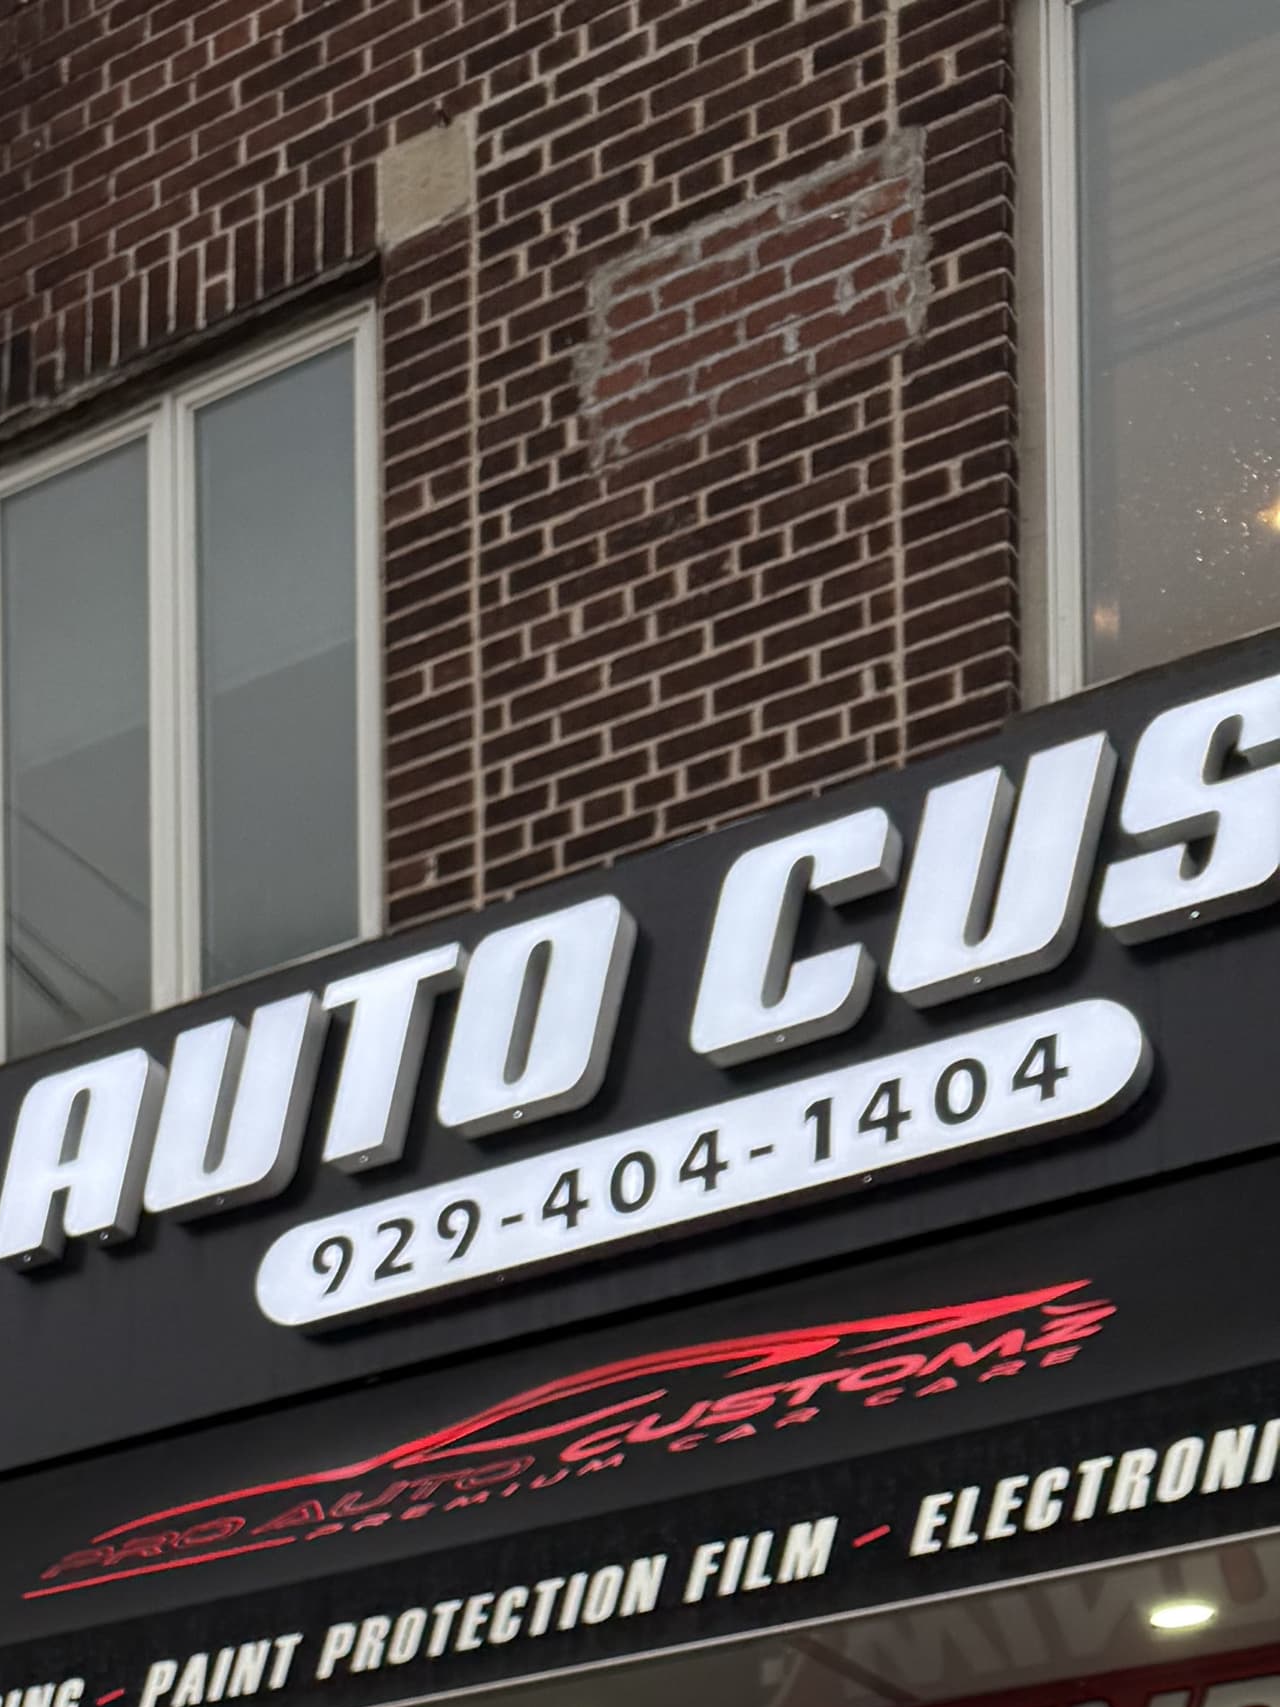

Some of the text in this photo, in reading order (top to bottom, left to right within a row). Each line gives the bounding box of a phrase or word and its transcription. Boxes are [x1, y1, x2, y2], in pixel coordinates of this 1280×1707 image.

[688, 679, 1280, 1063] CUS
[310, 1036, 1070, 1293] 929-404-1404
[306, 1345, 1083, 1541] PREMIUM CAR CARE
[314, 1553, 669, 1681] PROTECTION
[684, 1515, 840, 1602] FILM
